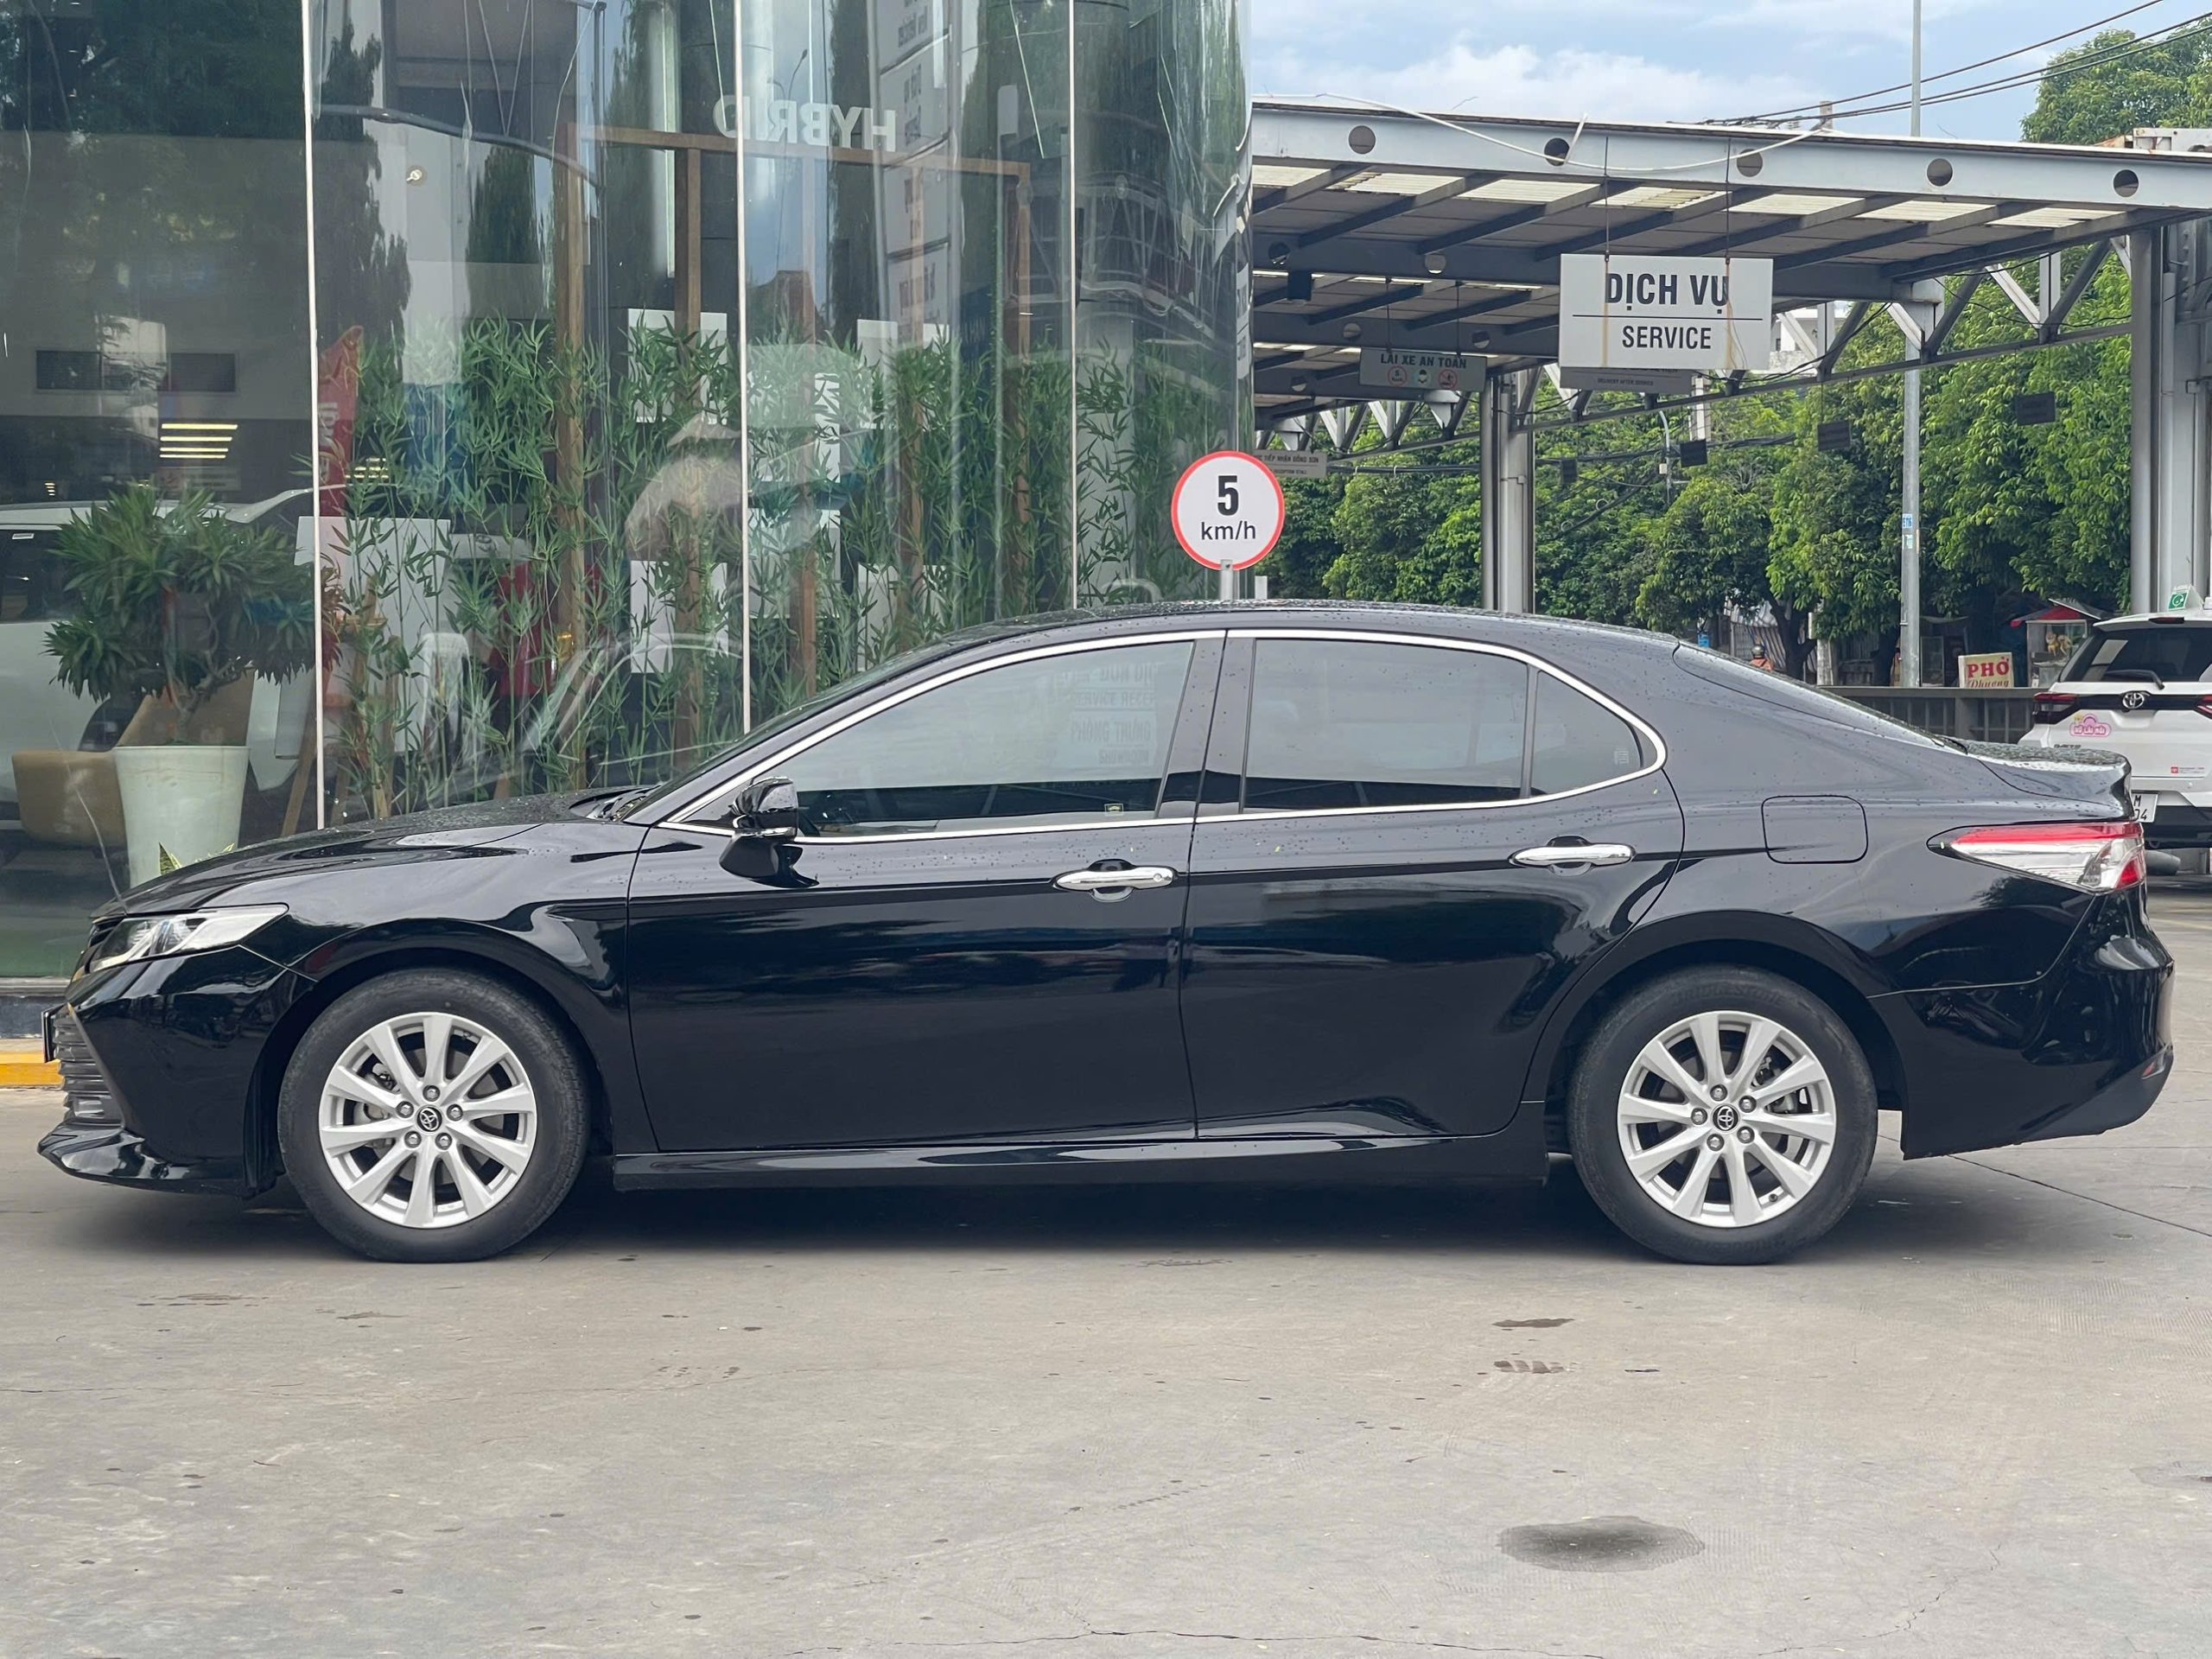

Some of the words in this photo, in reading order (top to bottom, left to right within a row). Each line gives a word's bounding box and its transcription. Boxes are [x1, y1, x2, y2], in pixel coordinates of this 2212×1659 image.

[1606, 273, 1678, 311] DỊCH
[1689, 274, 1729, 315] VỤ
[1622, 325, 1712, 350] SERVICE
[1402, 354, 1416, 366] XE
[1419, 356, 1434, 367] AN
[1217, 475, 1239, 516] 5
[1201, 520, 1256, 540] km/h
[1967, 655, 2010, 678] PHỞ
[2133, 794, 2142, 807] M
